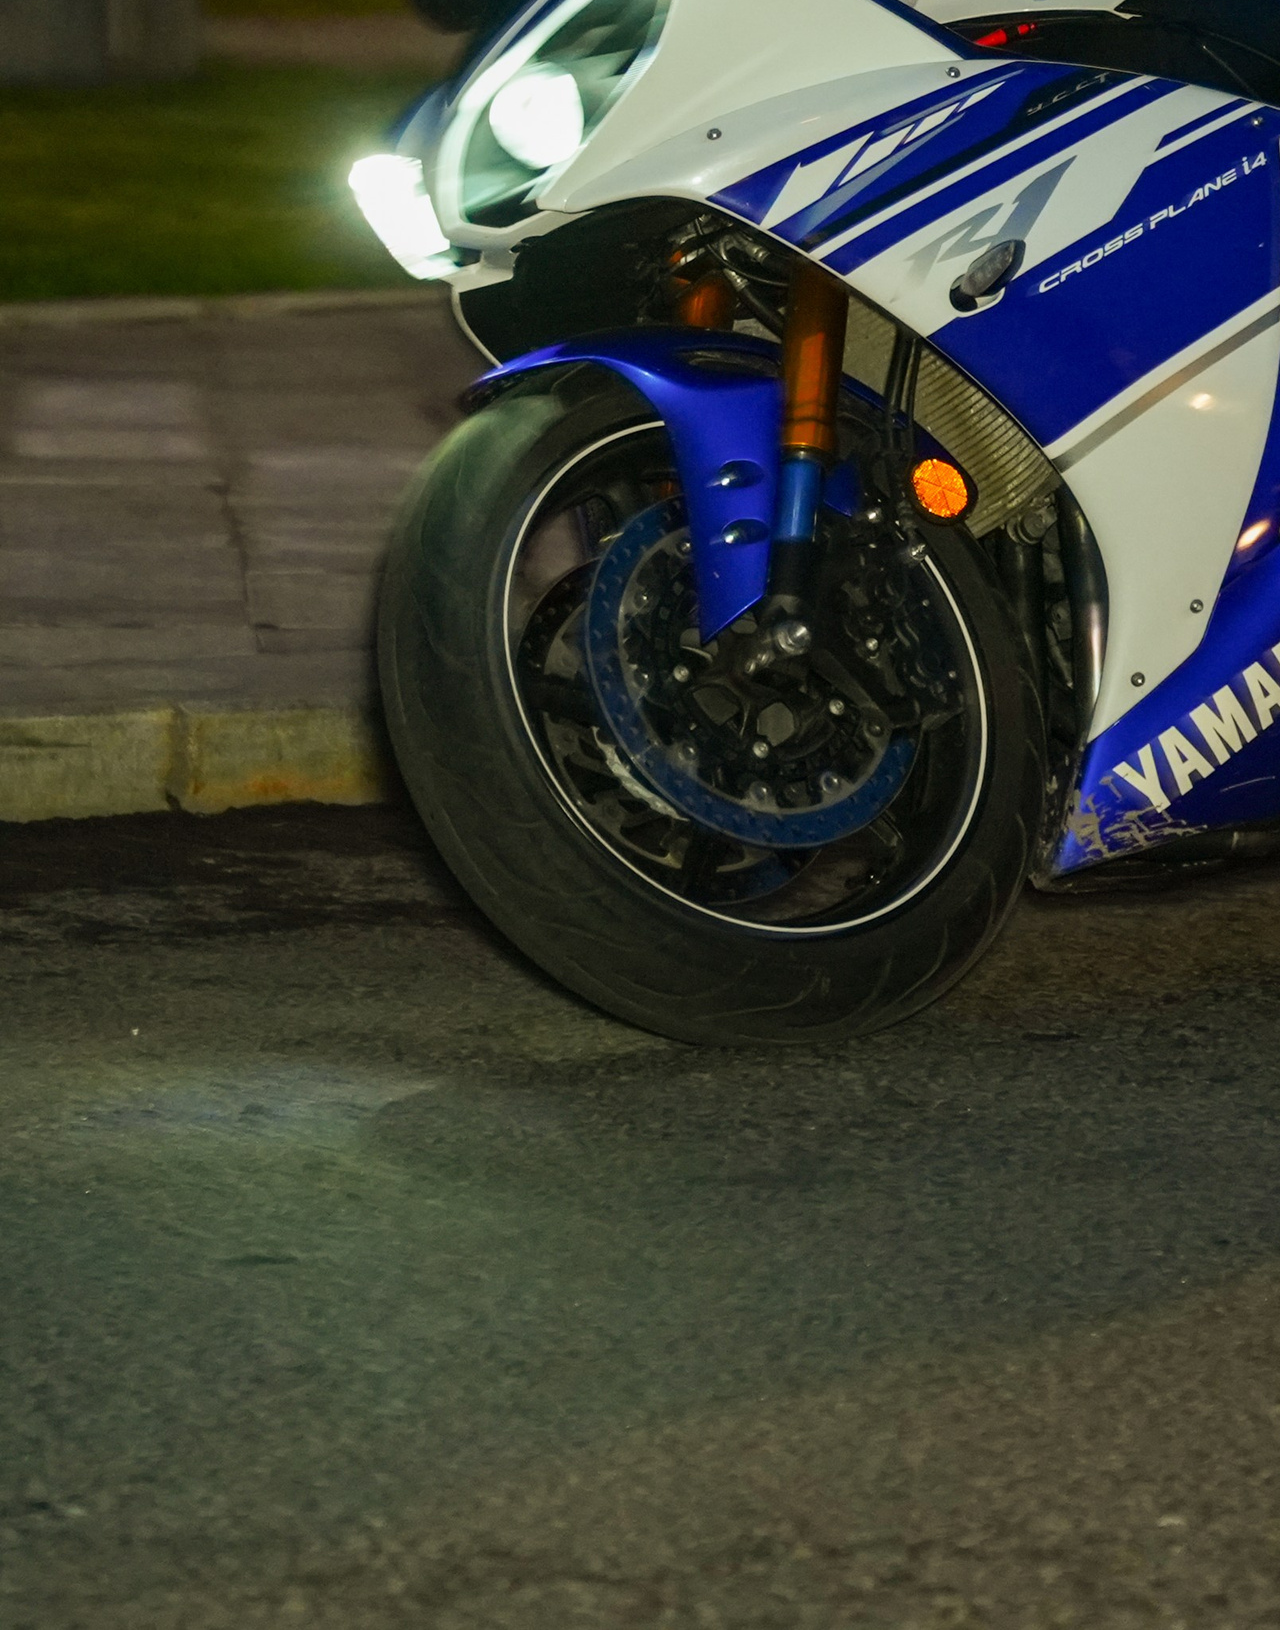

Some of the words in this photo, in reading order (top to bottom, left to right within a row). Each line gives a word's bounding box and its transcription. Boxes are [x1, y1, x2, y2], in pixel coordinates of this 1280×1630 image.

[1039, 223, 1144, 293] CROSS
[1150, 168, 1237, 230] PLANE
[1242, 151, 1267, 175] i4
